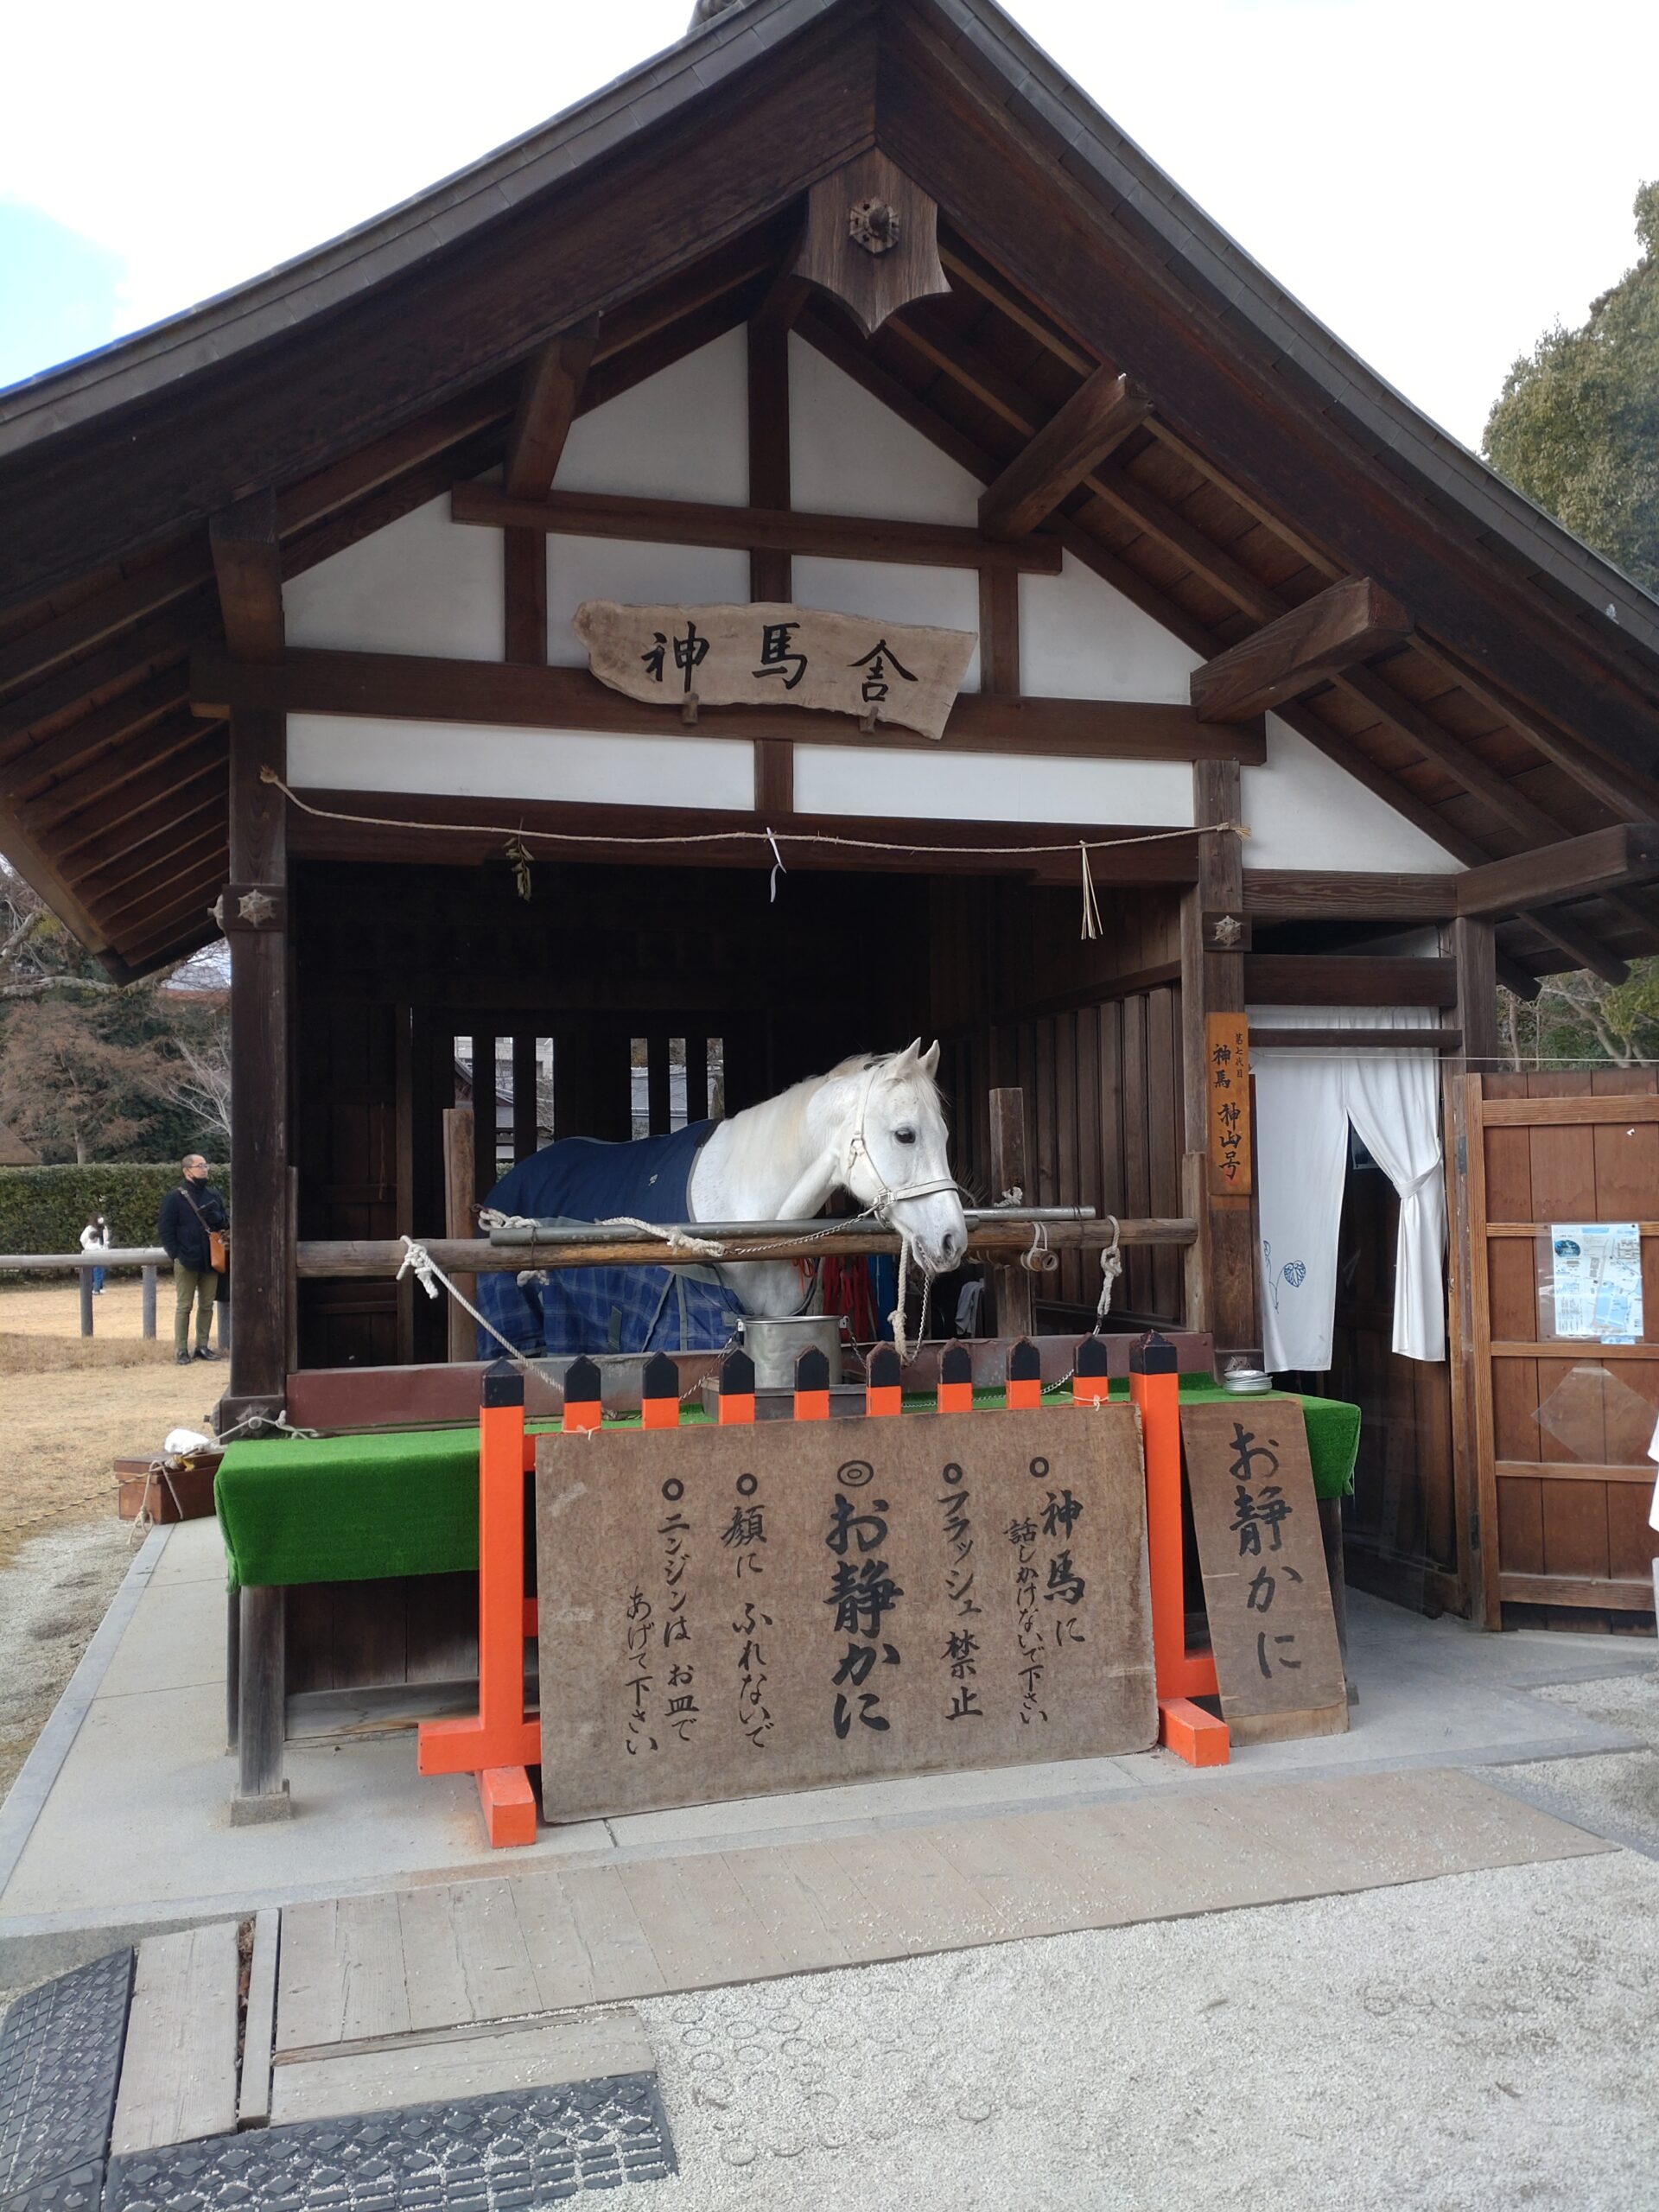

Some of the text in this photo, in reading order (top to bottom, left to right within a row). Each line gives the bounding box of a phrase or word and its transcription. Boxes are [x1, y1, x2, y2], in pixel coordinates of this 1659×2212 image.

[641, 621, 918, 703] 神馬舎
[823, 1493, 905, 1739] お静かに
[1003, 1517, 1048, 1724] 話しかけないで下さい
[1229, 1422, 1304, 1679] お静かに
[625, 1586, 658, 1755] あげて下さい
